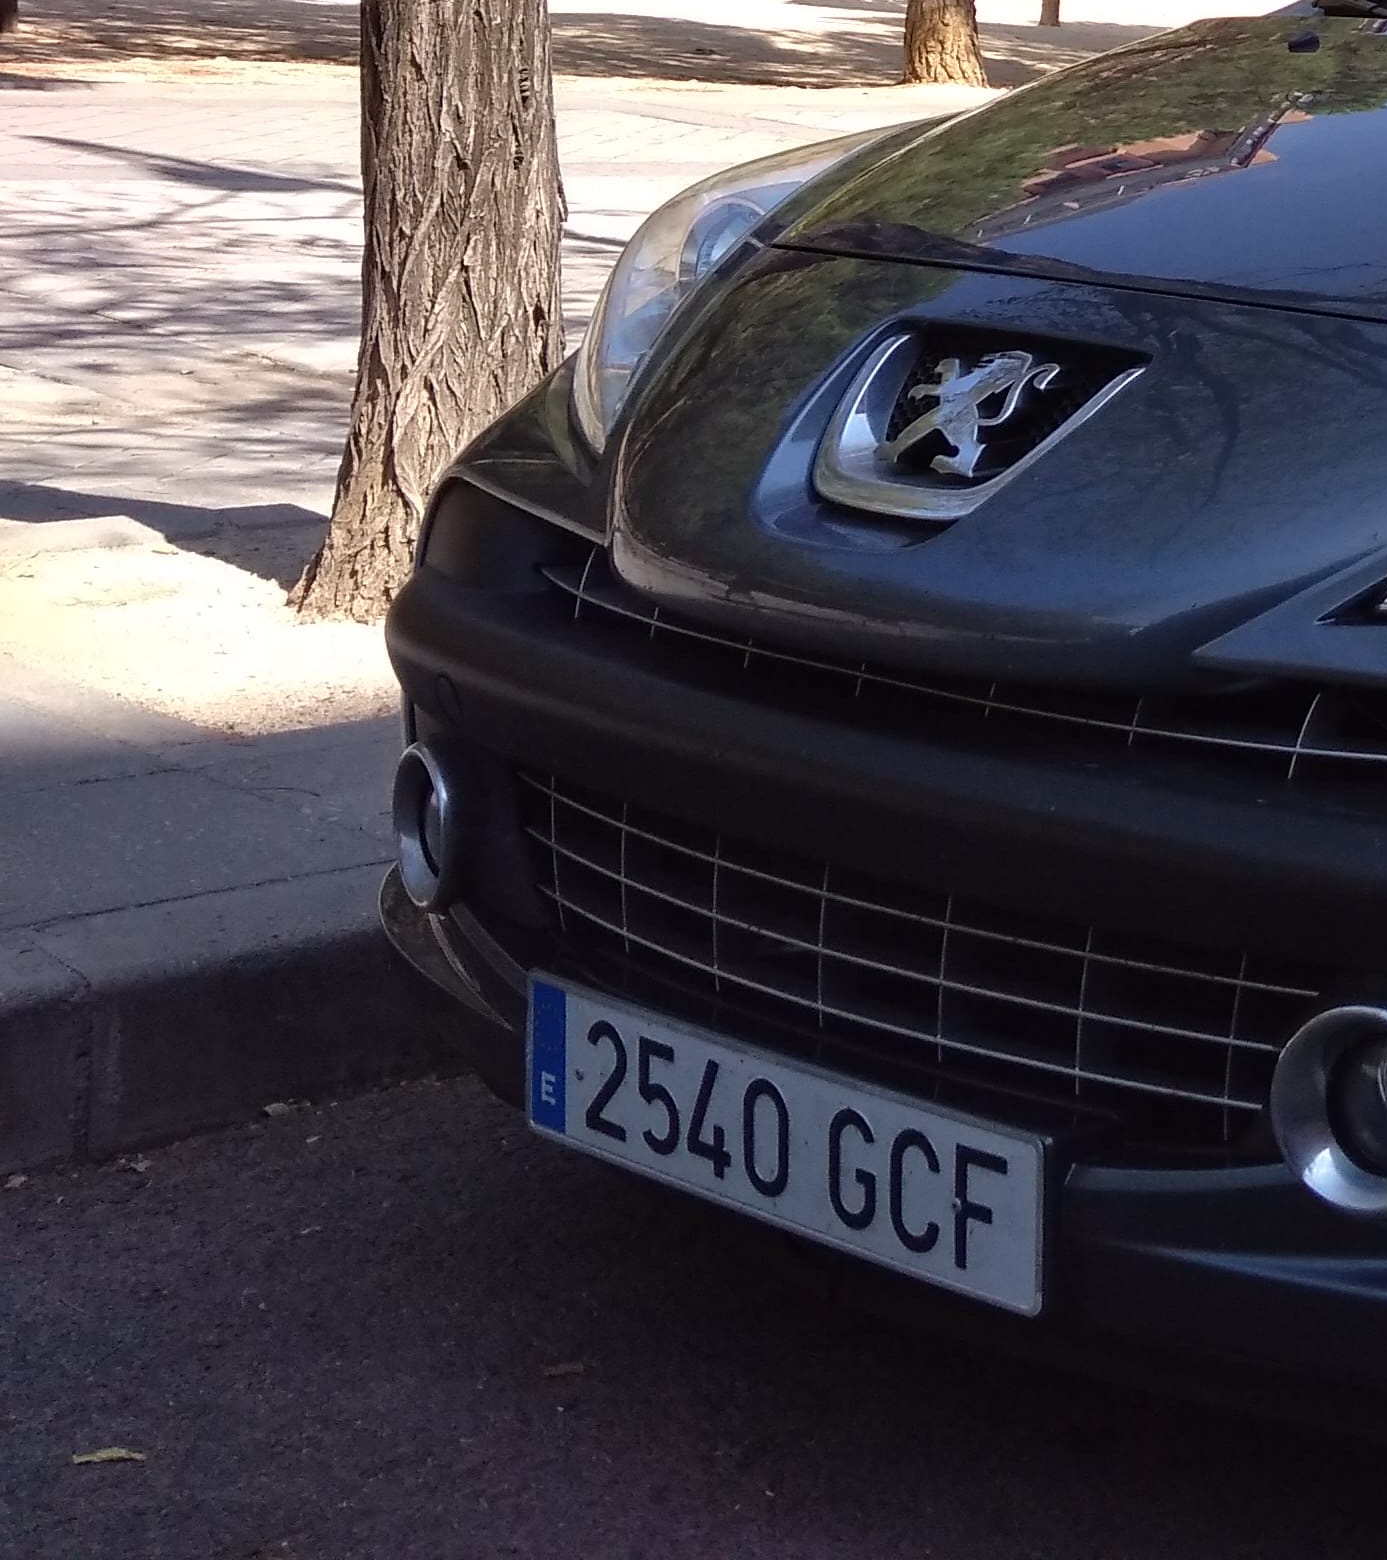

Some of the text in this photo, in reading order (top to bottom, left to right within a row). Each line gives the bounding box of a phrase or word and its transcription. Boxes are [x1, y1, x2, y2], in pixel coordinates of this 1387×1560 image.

[541, 1019, 1009, 1270] E 2540 GCF
